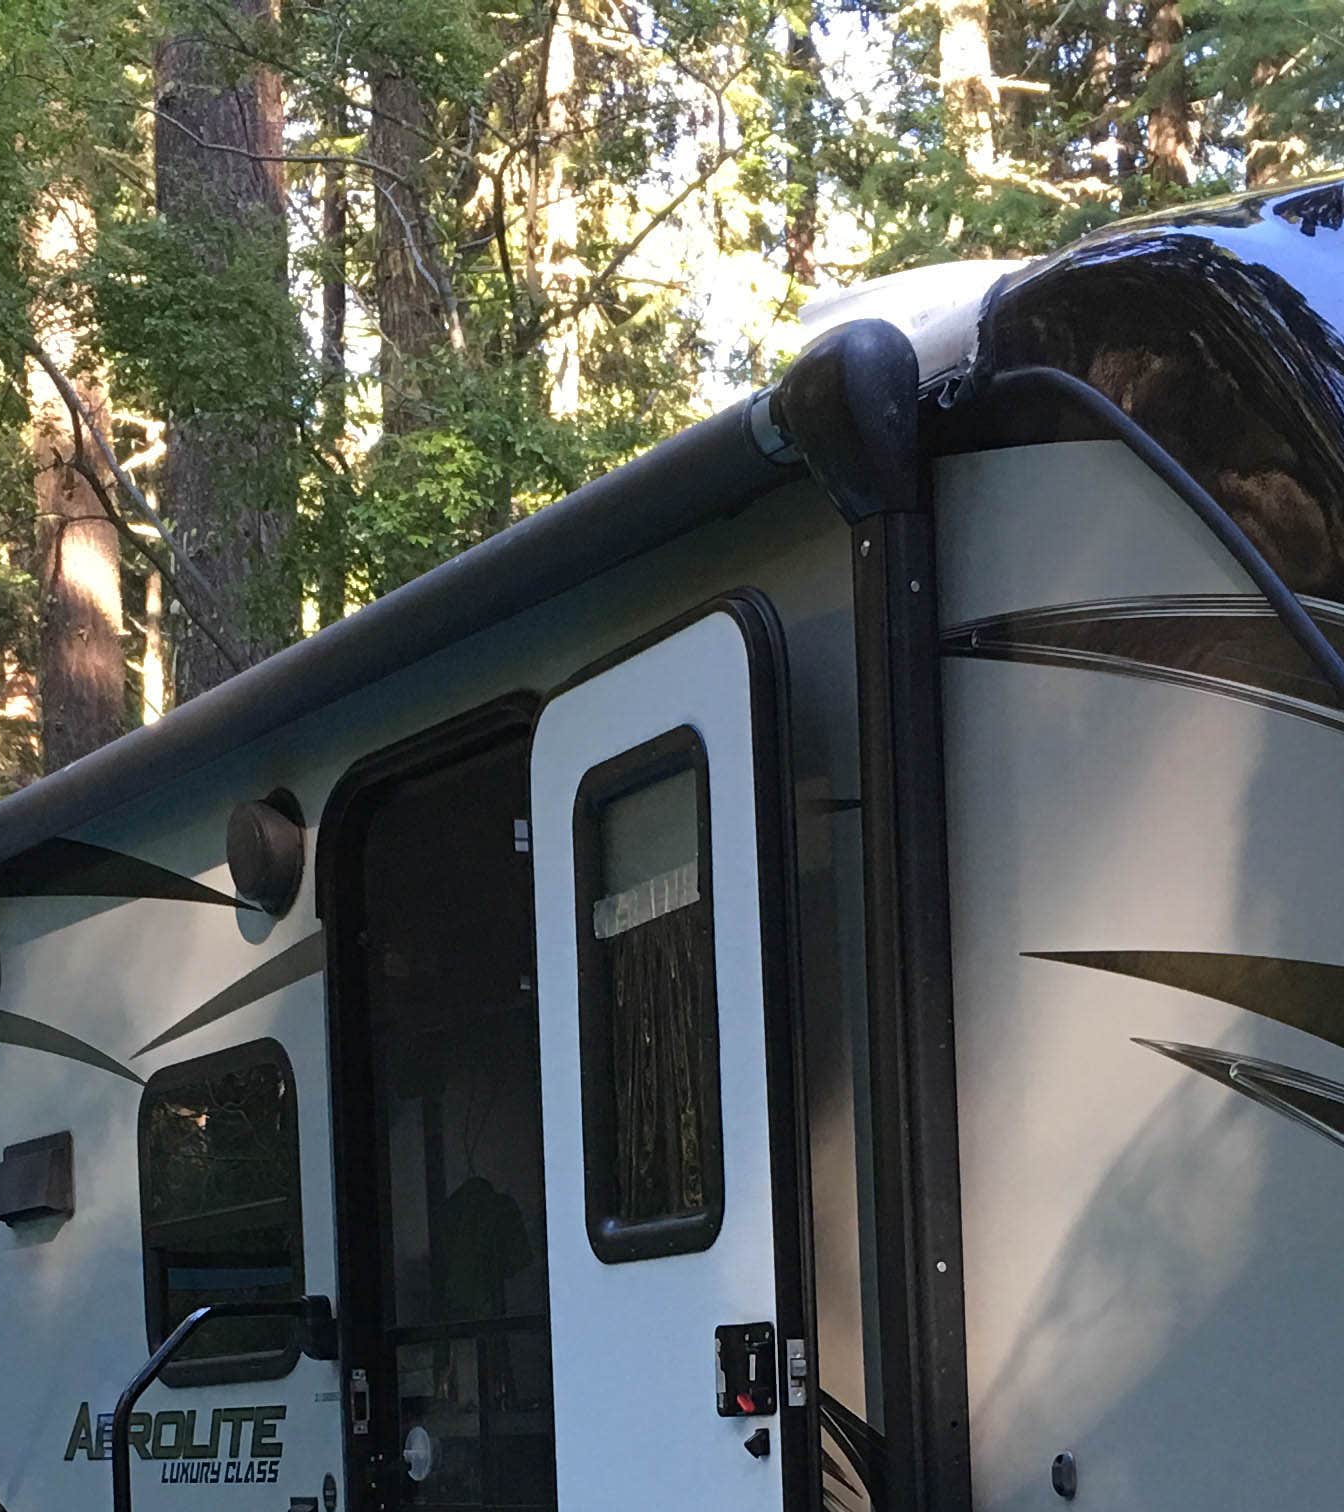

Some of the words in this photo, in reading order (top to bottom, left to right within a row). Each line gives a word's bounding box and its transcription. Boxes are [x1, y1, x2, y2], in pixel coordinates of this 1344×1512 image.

[64, 1402, 287, 1461] AEROLITE
[161, 1461, 221, 1484] LUXURY
[224, 1460, 280, 1483] CLASS
